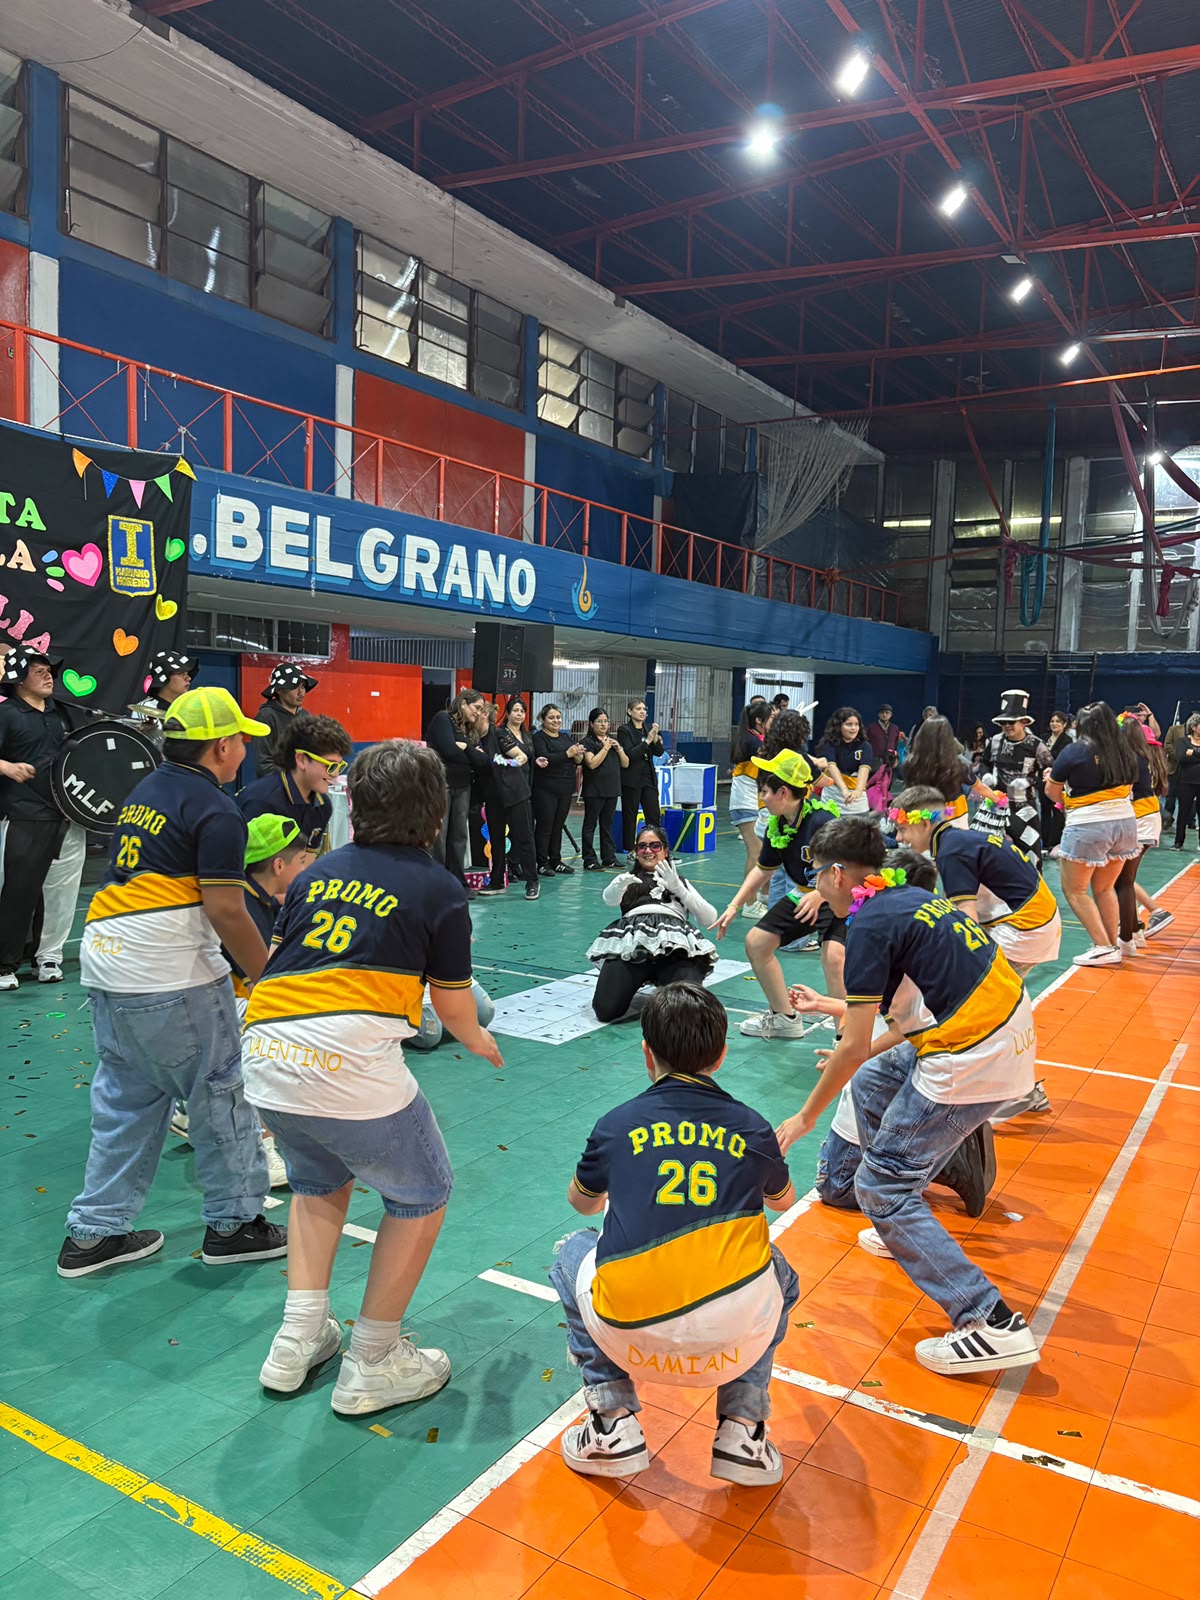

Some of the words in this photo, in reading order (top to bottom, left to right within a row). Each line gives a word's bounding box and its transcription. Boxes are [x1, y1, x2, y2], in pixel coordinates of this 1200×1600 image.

[117, 804, 167, 836] PROMO
[116, 834, 142, 869] 26
[305, 878, 399, 918] PROMO
[302, 909, 358, 954] 26
[952, 917, 990, 952] 26
[248, 1035, 343, 1073] VALENTINO
[628, 1121, 747, 1160] PROMO
[656, 1160, 718, 1206] 26
[627, 1343, 741, 1376] DAMIAN
